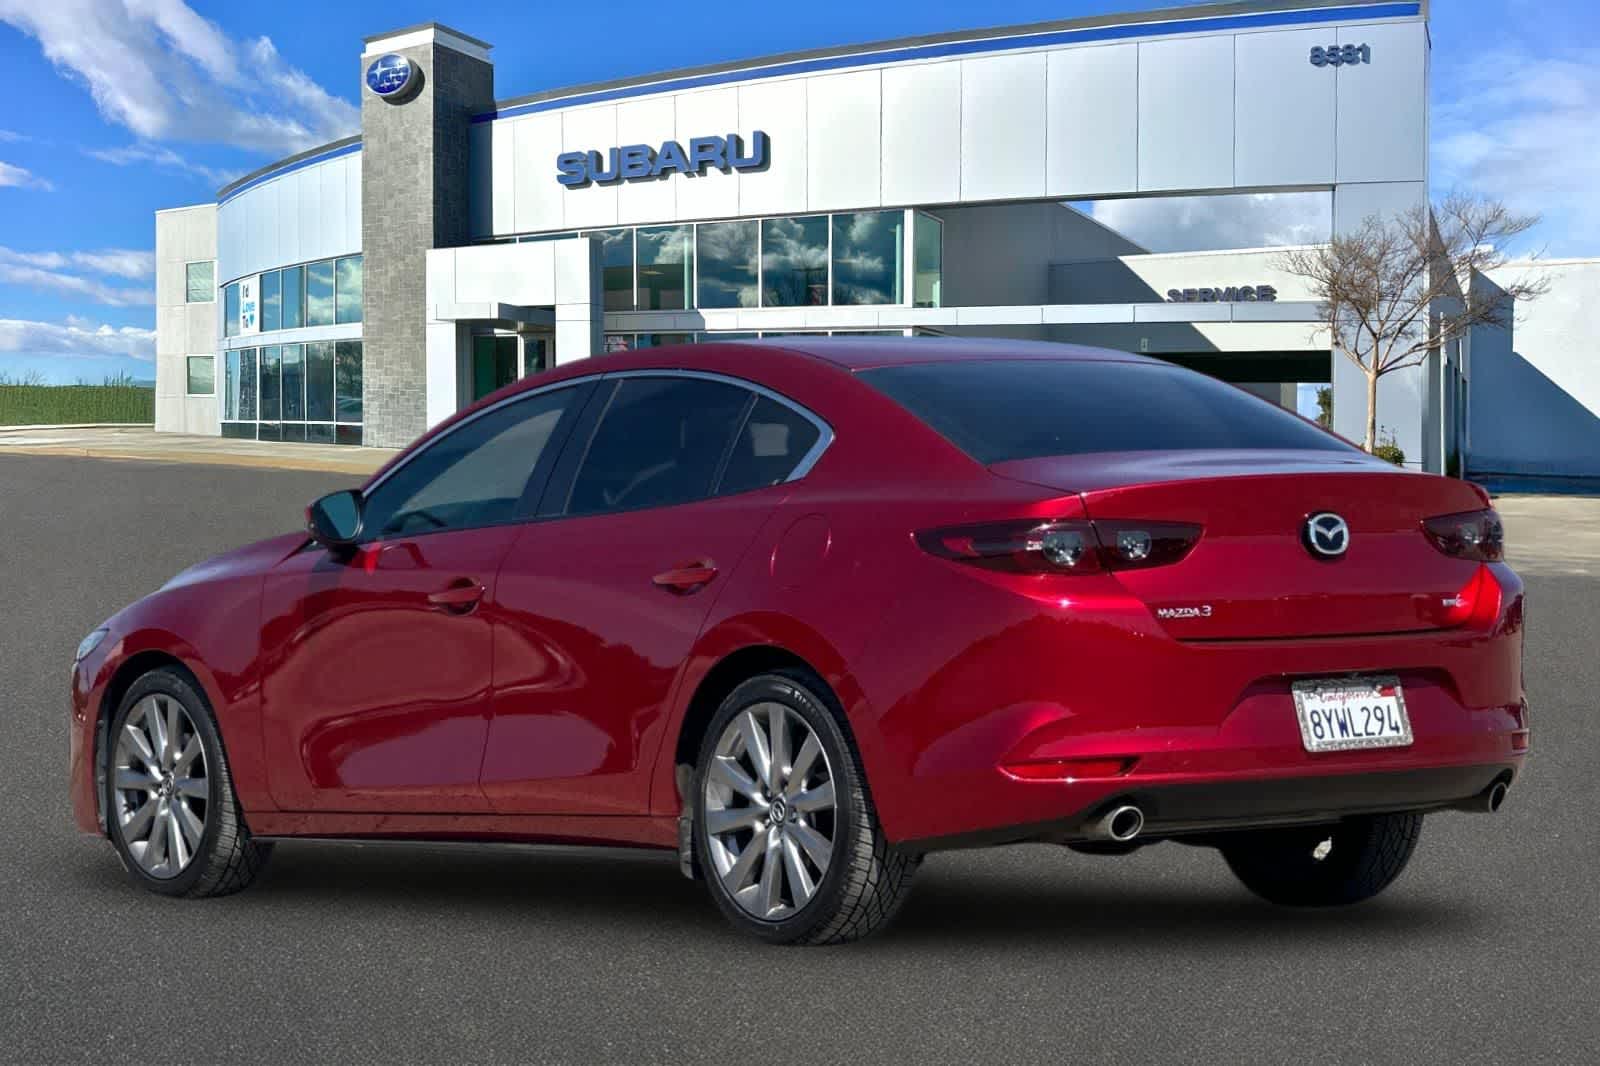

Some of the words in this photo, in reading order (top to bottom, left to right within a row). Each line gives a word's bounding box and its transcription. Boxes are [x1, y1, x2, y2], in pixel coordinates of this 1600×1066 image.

[556, 130, 771, 190] SUBARU
[1167, 284, 1277, 302] SERVICE
[1310, 704, 1400, 740] 8YWL294
